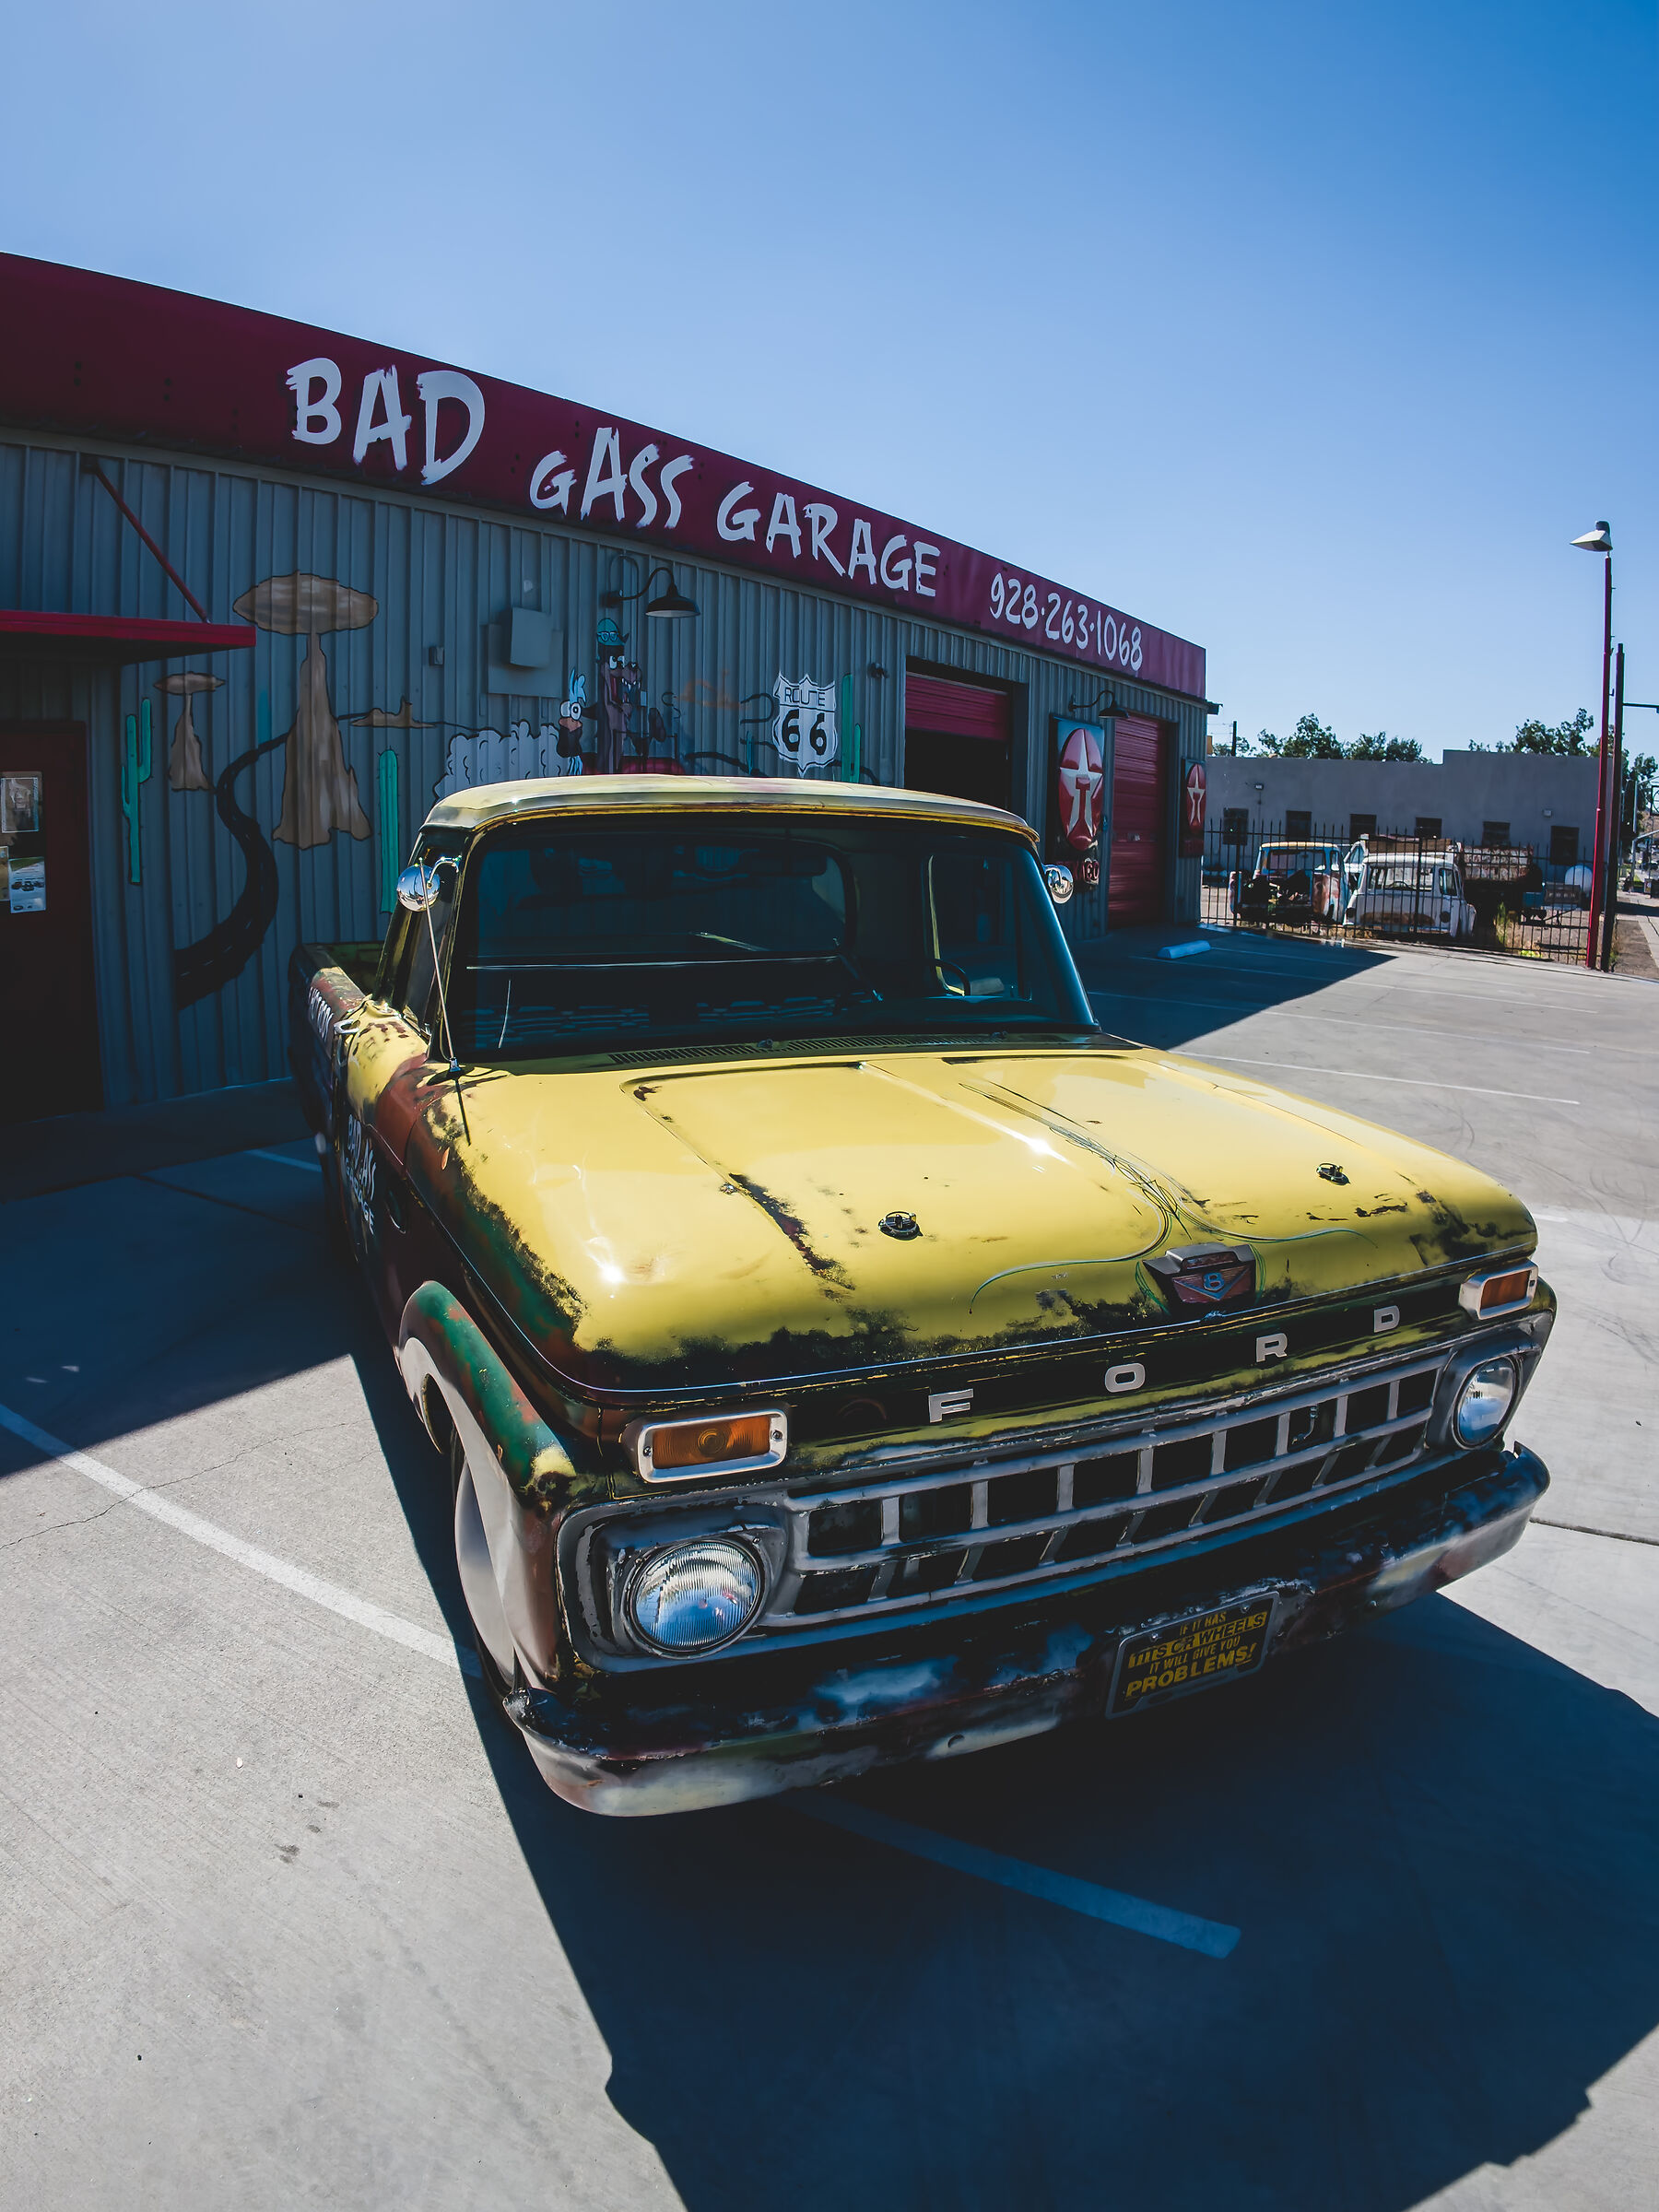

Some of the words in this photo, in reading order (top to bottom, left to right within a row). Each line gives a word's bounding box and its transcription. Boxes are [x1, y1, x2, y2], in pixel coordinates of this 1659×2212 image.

[286, 357, 485, 486] BAD
[530, 428, 693, 529] GASS
[717, 481, 940, 596] GARAGE
[784, 687, 826, 707] ROUTE
[782, 709, 827, 756] 66
[928, 1305, 1400, 1423] FORD
[1180, 1624, 1188, 1636] IF
[1193, 1619, 1203, 1632] IT
[1205, 1612, 1227, 1629] HAS
[1199, 1613, 1264, 1646] WHEELS
[1125, 1642, 1257, 1697] PROBLEMS!
[1149, 1662, 1161, 1675] IT
[1163, 1653, 1188, 1670] WILL
[1193, 1643, 1217, 1660] GIVE
[1221, 1635, 1241, 1652] YOU
